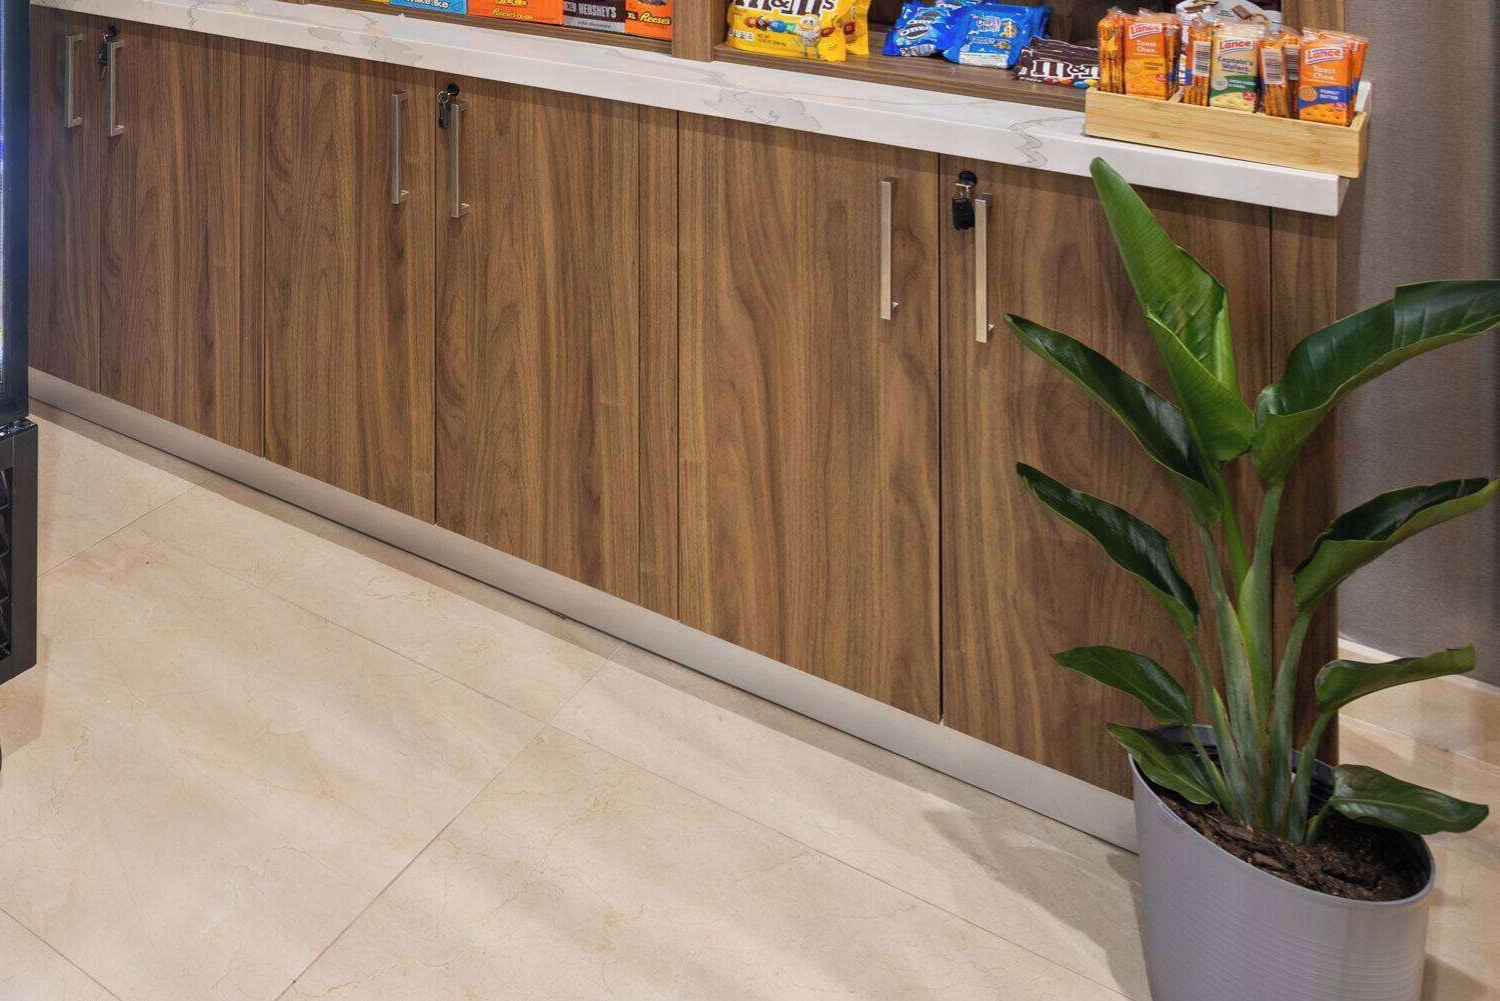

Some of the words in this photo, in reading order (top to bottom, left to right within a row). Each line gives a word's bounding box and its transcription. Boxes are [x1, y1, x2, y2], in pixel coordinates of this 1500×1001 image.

[579, 3, 617, 18] HERSHEY'S
[640, 12, 670, 25] Reese's
[1130, 24, 1162, 34] Lance
[1220, 40, 1252, 50] Lance
[1306, 49, 1342, 59] Lance
